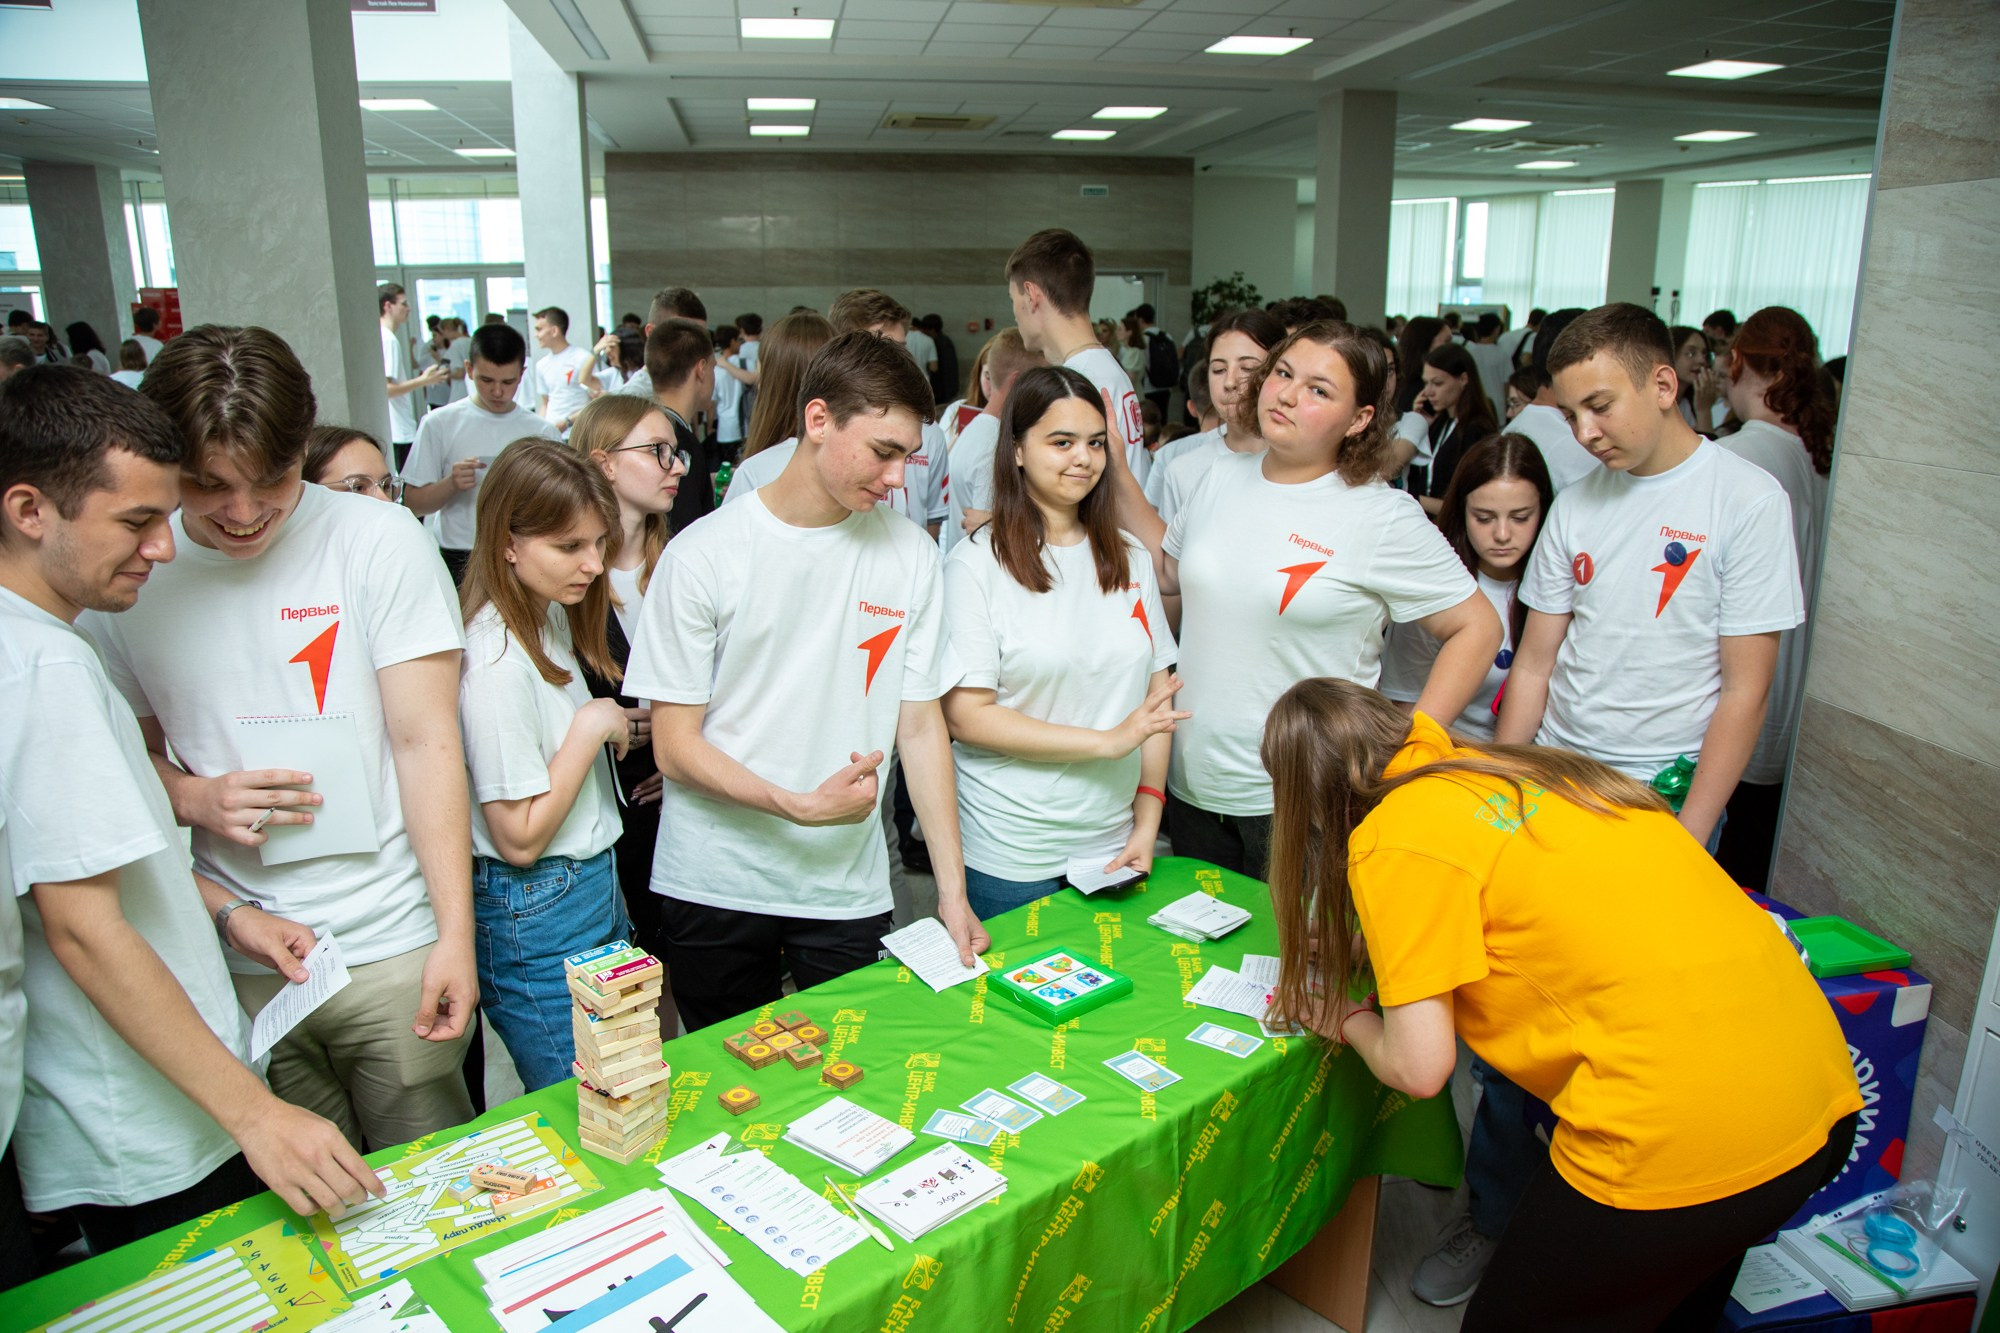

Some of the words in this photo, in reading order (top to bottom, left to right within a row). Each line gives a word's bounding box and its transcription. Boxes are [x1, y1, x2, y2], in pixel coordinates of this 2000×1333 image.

[1660, 526, 1706, 543] Первые
[1288, 532, 1335, 557] Первые
[281, 604, 340, 622] Первые
[859, 601, 906, 618] Первые
[1112, 924, 1122, 939] БАНК
[1098, 924, 1114, 970] ЦЕНТР-ИНВЕС
[1191, 957, 1203, 973] БАНК
[846, 1025, 862, 1044] БАНК
[922, 1071, 937, 1092] БАНК
[682, 1089, 703, 1113] БАНК
[1197, 1126, 1220, 1163] БАНК
[1149, 1121, 1215, 1239] ЦЕНТР-ИНВЕСТ
[1299, 1160, 1319, 1195] БАНК
[936, 1190, 966, 1206] Ребус
[1054, 1200, 1085, 1238] БАНК
[1257, 1158, 1317, 1262] ЦЕНТР-ИНВЕСТ
[443, 1228, 468, 1241] пару
[241, 1240, 253, 1248] 6
[1189, 1234, 1211, 1271] БАНК
[250, 1250, 261, 1261] 5
[1007, 1194, 1079, 1328] ЦЕНТР-ИНВЕСТ
[258, 1262, 271, 1272] 4
[267, 1272, 280, 1283] 3
[274, 1283, 288, 1294] 2
[284, 1296, 296, 1307] 1
